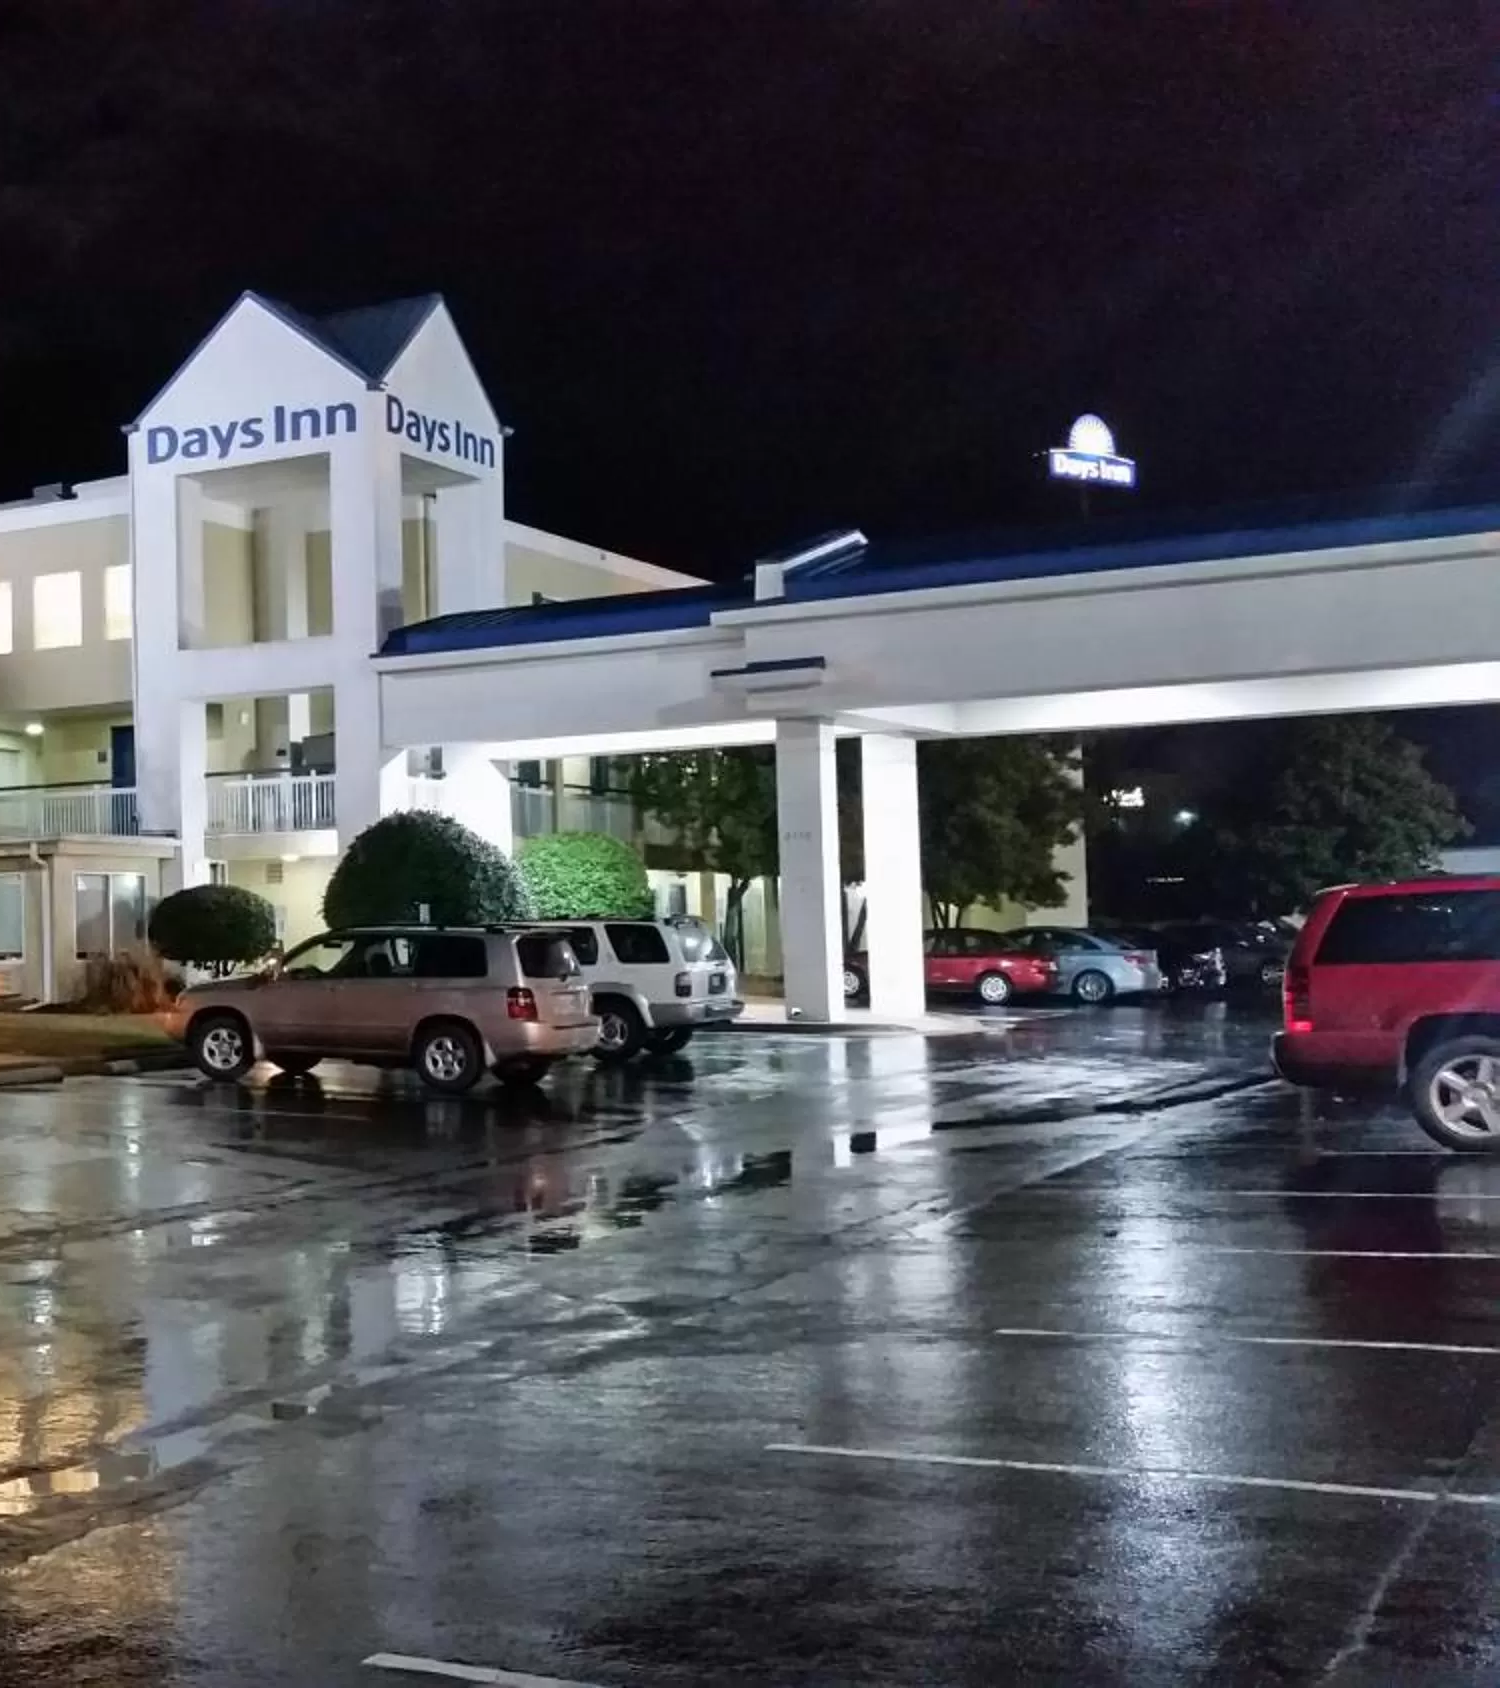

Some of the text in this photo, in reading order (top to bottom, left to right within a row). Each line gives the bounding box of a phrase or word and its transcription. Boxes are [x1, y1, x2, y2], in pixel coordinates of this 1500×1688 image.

[147, 401, 357, 464] Days Inn
[386, 394, 496, 468] Days Inn
[1053, 453, 1131, 483] Days Inn
